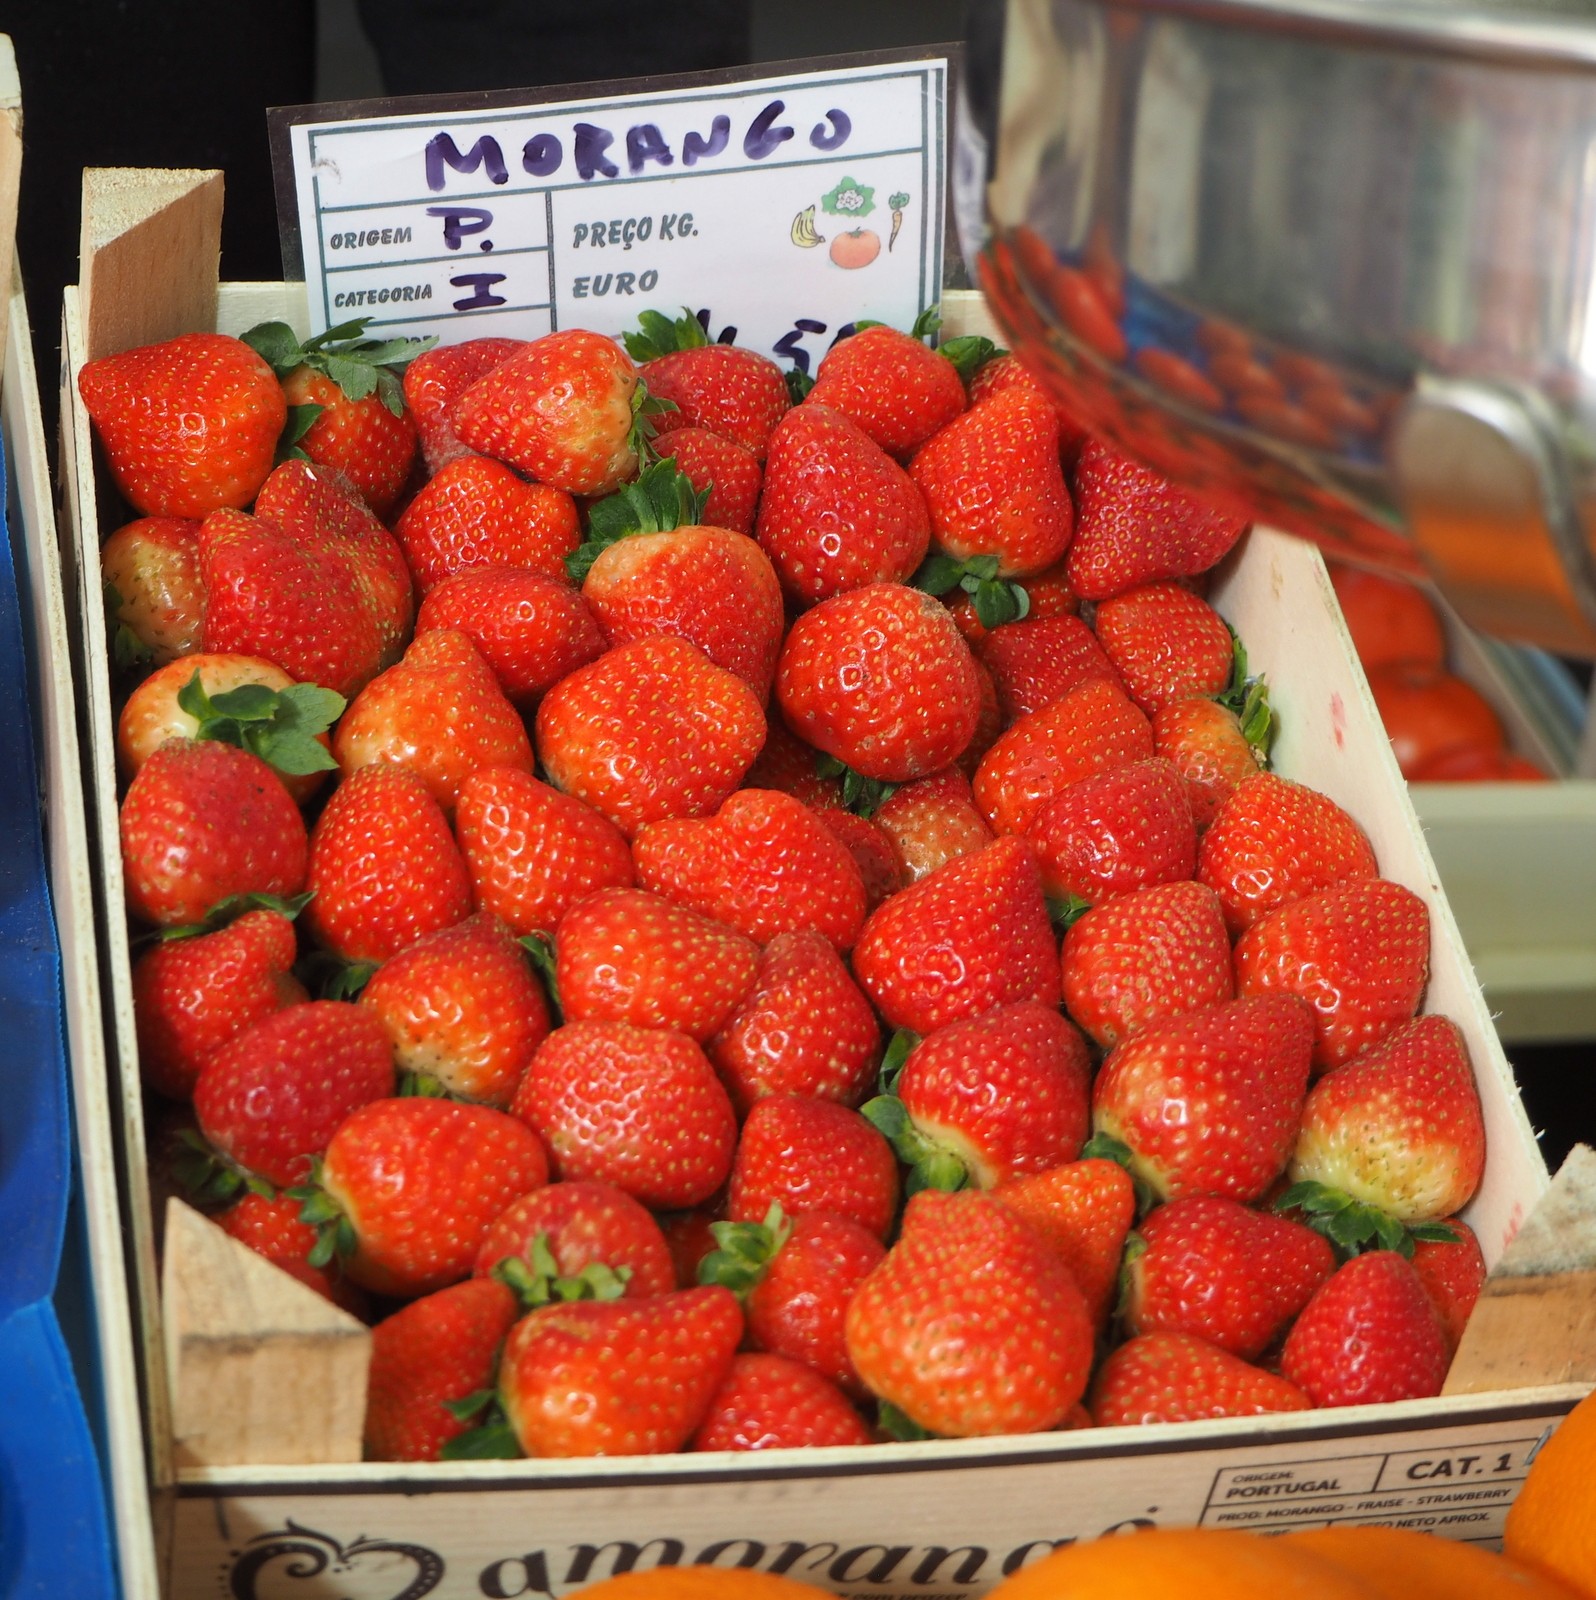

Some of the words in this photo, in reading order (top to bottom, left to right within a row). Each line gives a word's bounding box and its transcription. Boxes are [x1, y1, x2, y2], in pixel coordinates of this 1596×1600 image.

[424, 98, 851, 192] MORANGO
[330, 226, 412, 250] ORIGEM
[426, 206, 494, 252] P.
[572, 213, 652, 250] PREÇO
[659, 212, 699, 238] KG.
[334, 284, 433, 308] CATEGORIA
[450, 272, 508, 312] I
[572, 268, 659, 299] EURO
[1231, 1471, 1295, 1483] ORIGEM:
[1406, 1455, 1483, 1480] CAT.
[1492, 1452, 1512, 1473] 1
[1217, 1510, 1263, 1522] PROD:
[1265, 1503, 1345, 1518] MORANGO
[1356, 1498, 1403, 1512] FRAISE
[1416, 1488, 1512, 1506] STRAWBERRY
[1225, 1479, 1342, 1499] PORTUGAL
[1395, 1516, 1436, 1529] NETO
